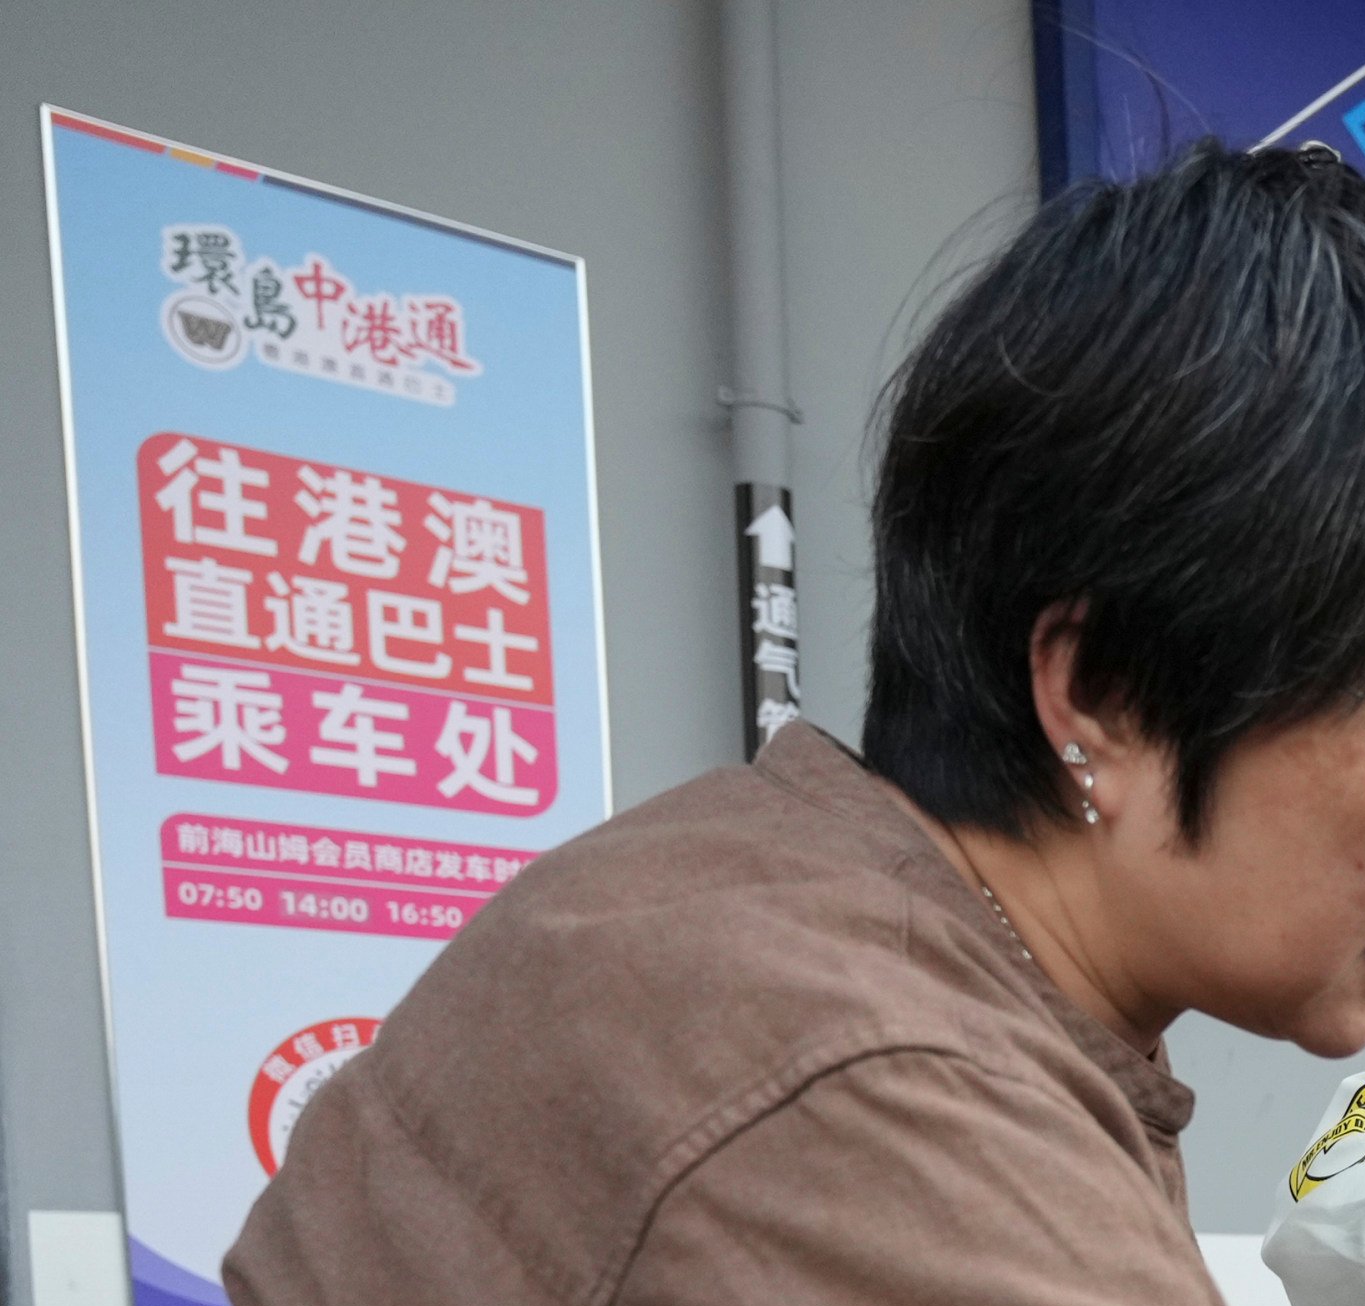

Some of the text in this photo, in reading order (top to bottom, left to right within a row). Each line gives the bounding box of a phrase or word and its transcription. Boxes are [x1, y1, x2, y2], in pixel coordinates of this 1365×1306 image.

[156, 438, 530, 605] 往港澳
[163, 556, 539, 691] 直通巴士
[171, 663, 540, 806] 乘车处
[177, 823, 528, 883] 前海山姆会员商店发车时
[178, 881, 463, 929] 07:50 14:00 16:50
